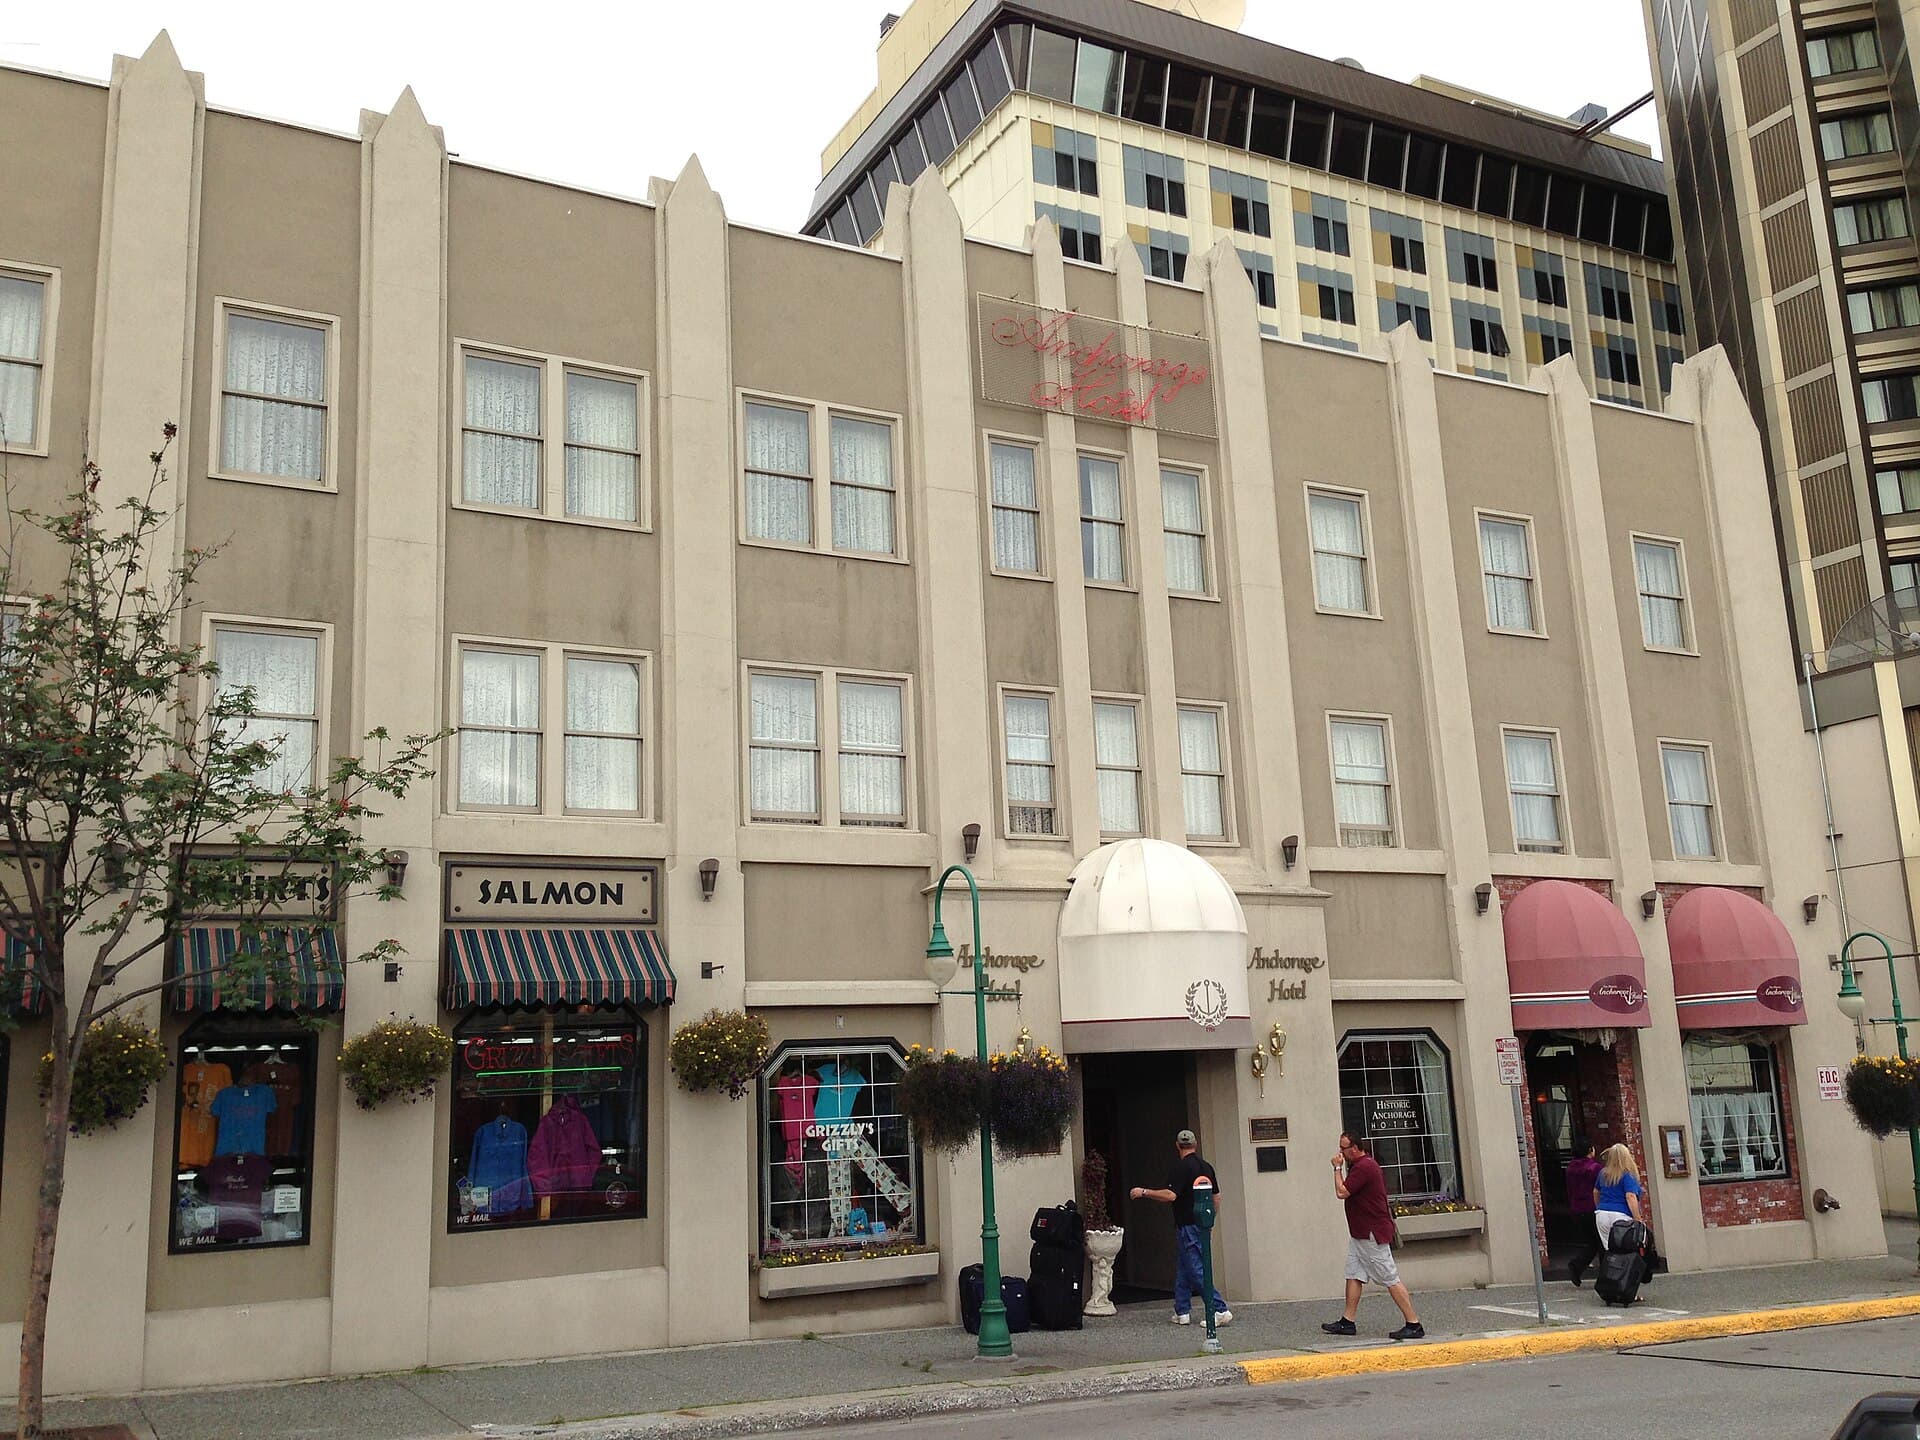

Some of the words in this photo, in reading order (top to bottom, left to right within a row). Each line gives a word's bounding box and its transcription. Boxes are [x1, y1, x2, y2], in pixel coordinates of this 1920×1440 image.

[991, 313, 1208, 404] Anchorage
[1030, 368, 1162, 421] Hotel
[478, 879, 624, 906] SALMON
[1247, 946, 1325, 974] Anchorage
[1267, 978, 1307, 1002] Hotel
[1820, 1070, 1840, 1083] F.D.C.
[1376, 1100, 1410, 1109] HISTORIC
[1372, 1111, 1416, 1120] ANCHORAGE
[805, 1122, 874, 1137] GRIZZLY'S
[821, 1139, 858, 1152] GIFTS
[456, 1215, 470, 1224] WE
[472, 1213, 491, 1222] MAIL
[179, 1237, 193, 1246] WE
[196, 1236, 217, 1245] MAIL
